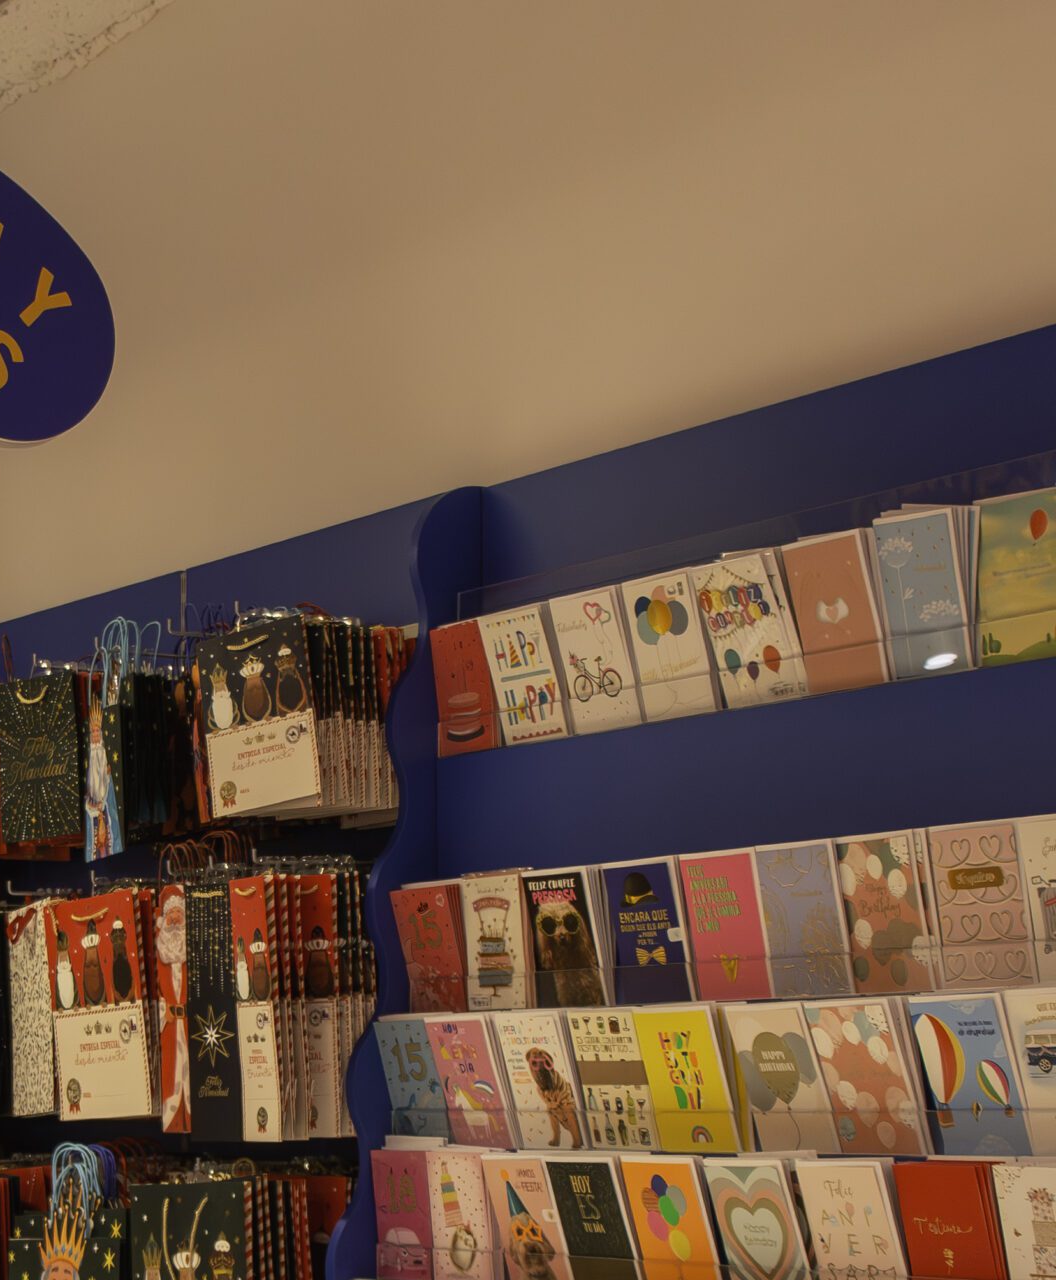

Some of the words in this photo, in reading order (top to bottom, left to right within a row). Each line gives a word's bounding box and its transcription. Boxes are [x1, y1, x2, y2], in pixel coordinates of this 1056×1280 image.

[19, 267, 72, 327] Y
[11, 760, 68, 783] Navidad
[619, 911, 650, 923] ENCARA
[652, 909, 669, 921] QUE
[391, 1038, 427, 1082] 15
[761, 1050, 785, 1060] HAPPY
[569, 1175, 592, 1193] HOY
[575, 1193, 601, 1220] ES
